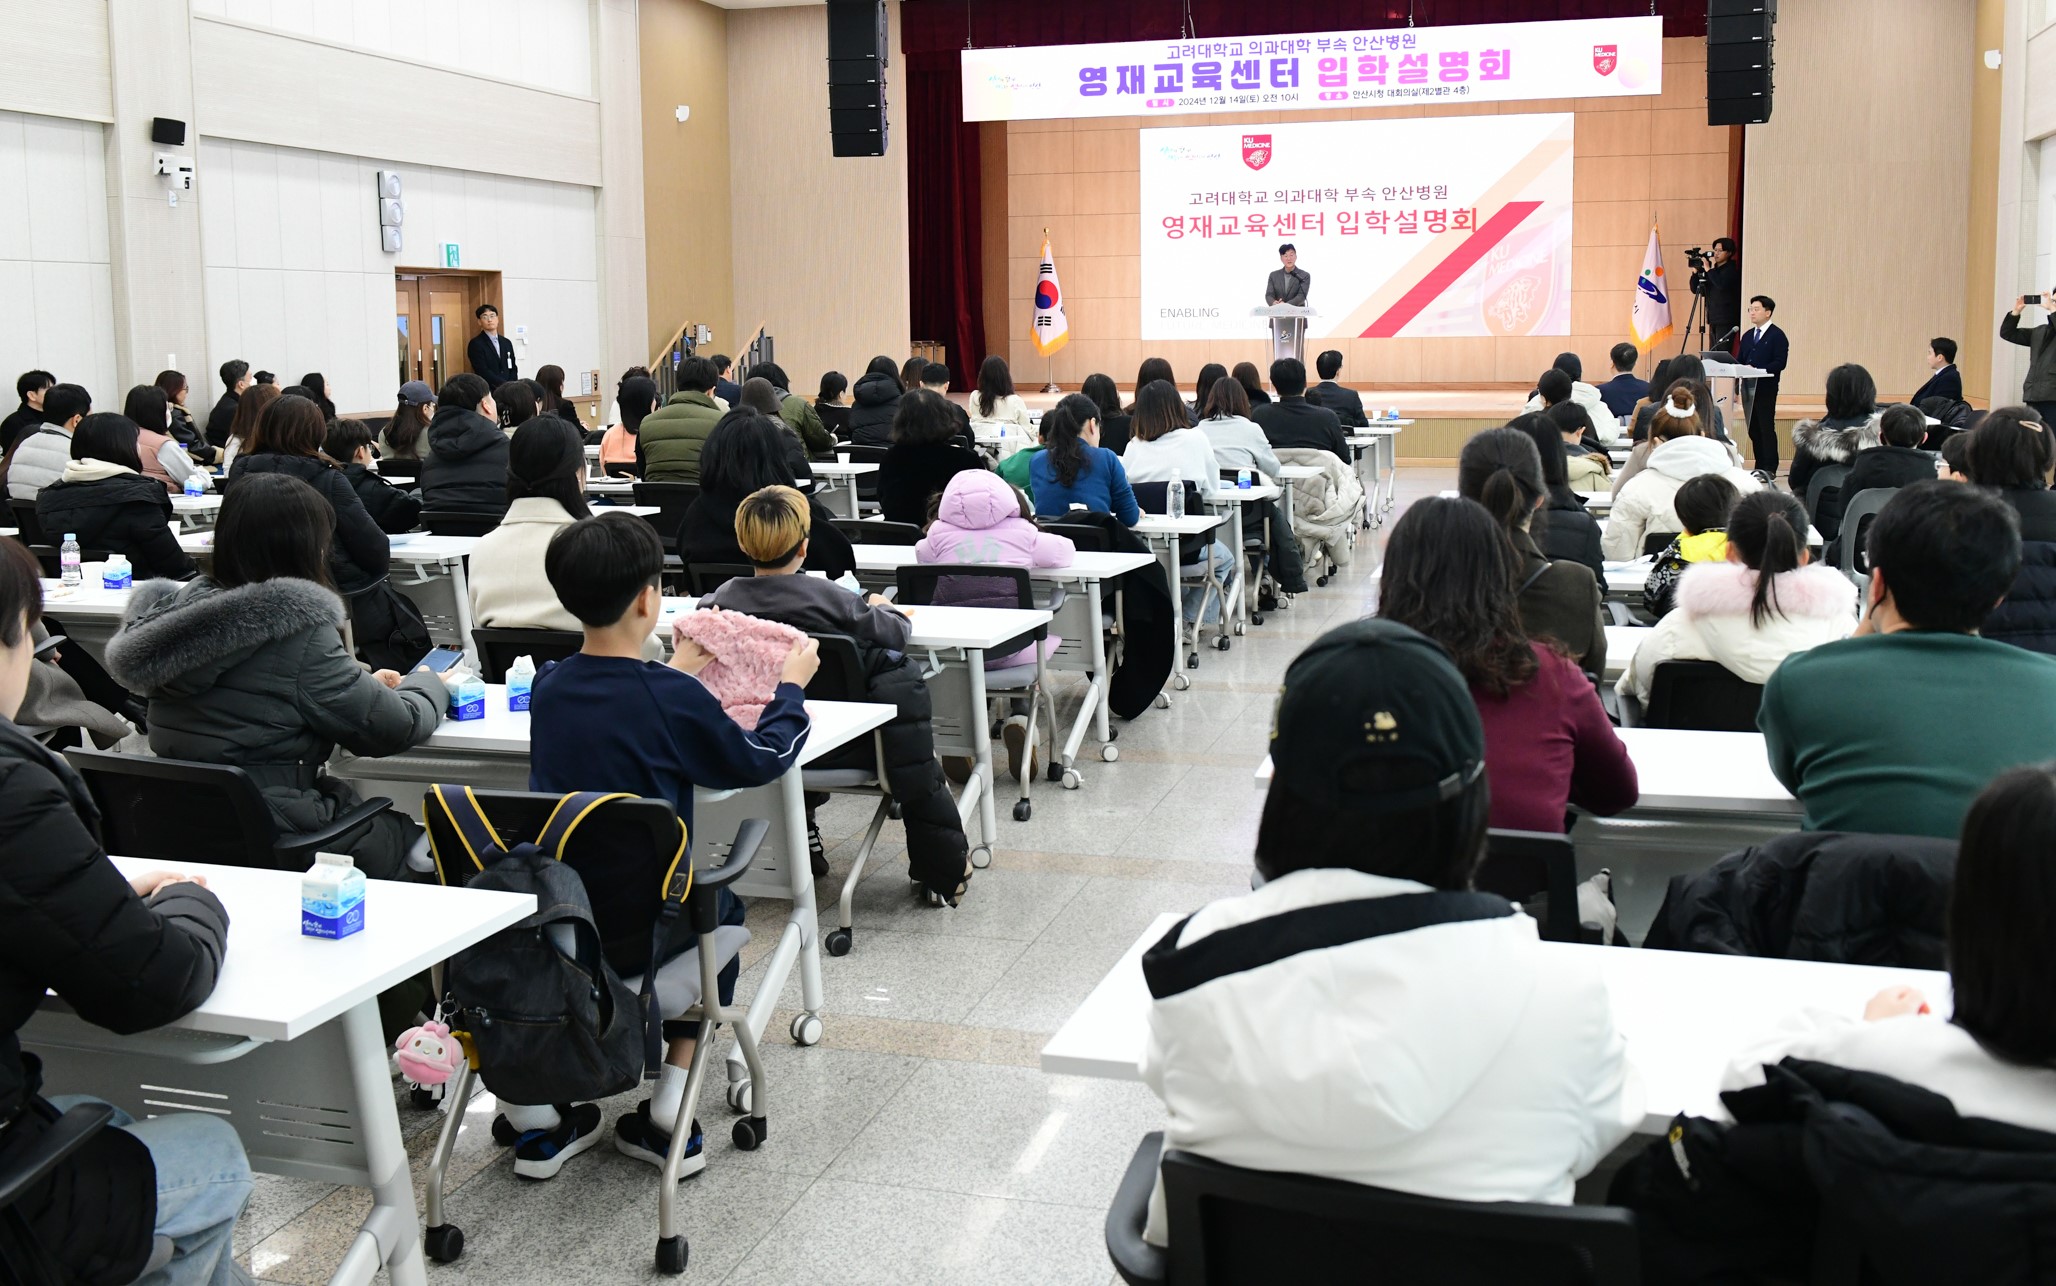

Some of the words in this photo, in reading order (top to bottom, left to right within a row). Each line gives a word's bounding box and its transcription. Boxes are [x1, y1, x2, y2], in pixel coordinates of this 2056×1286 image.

[1167, 42, 1243, 60] 고려대학교
[1249, 38, 1311, 56] 의과대학
[1317, 37, 1347, 53] 부속
[1352, 33, 1416, 52] 안산병원
[1078, 57, 1299, 97] 영재교육센터
[1317, 48, 1511, 88] 입학설명회
[1178, 96, 1207, 106] 2024년
[1209, 95, 1227, 105] 12월
[1229, 93, 1260, 104] 14일(토)
[1262, 93, 1278, 103] 오전
[1280, 92, 1299, 102] 10시
[1352, 89, 1384, 100] 안산시청
[1453, 85, 1470, 96] 4층)
[1188, 190, 1269, 207] 고려대학교
[1273, 188, 1340, 206] 의과대학
[1344, 187, 1377, 203] 부속
[1381, 184, 1448, 201] 안산병원
[1161, 211, 1325, 240] 영재교육센터
[1336, 207, 1478, 236] 입학설명회
[1160, 307, 1220, 318] ENABLING
